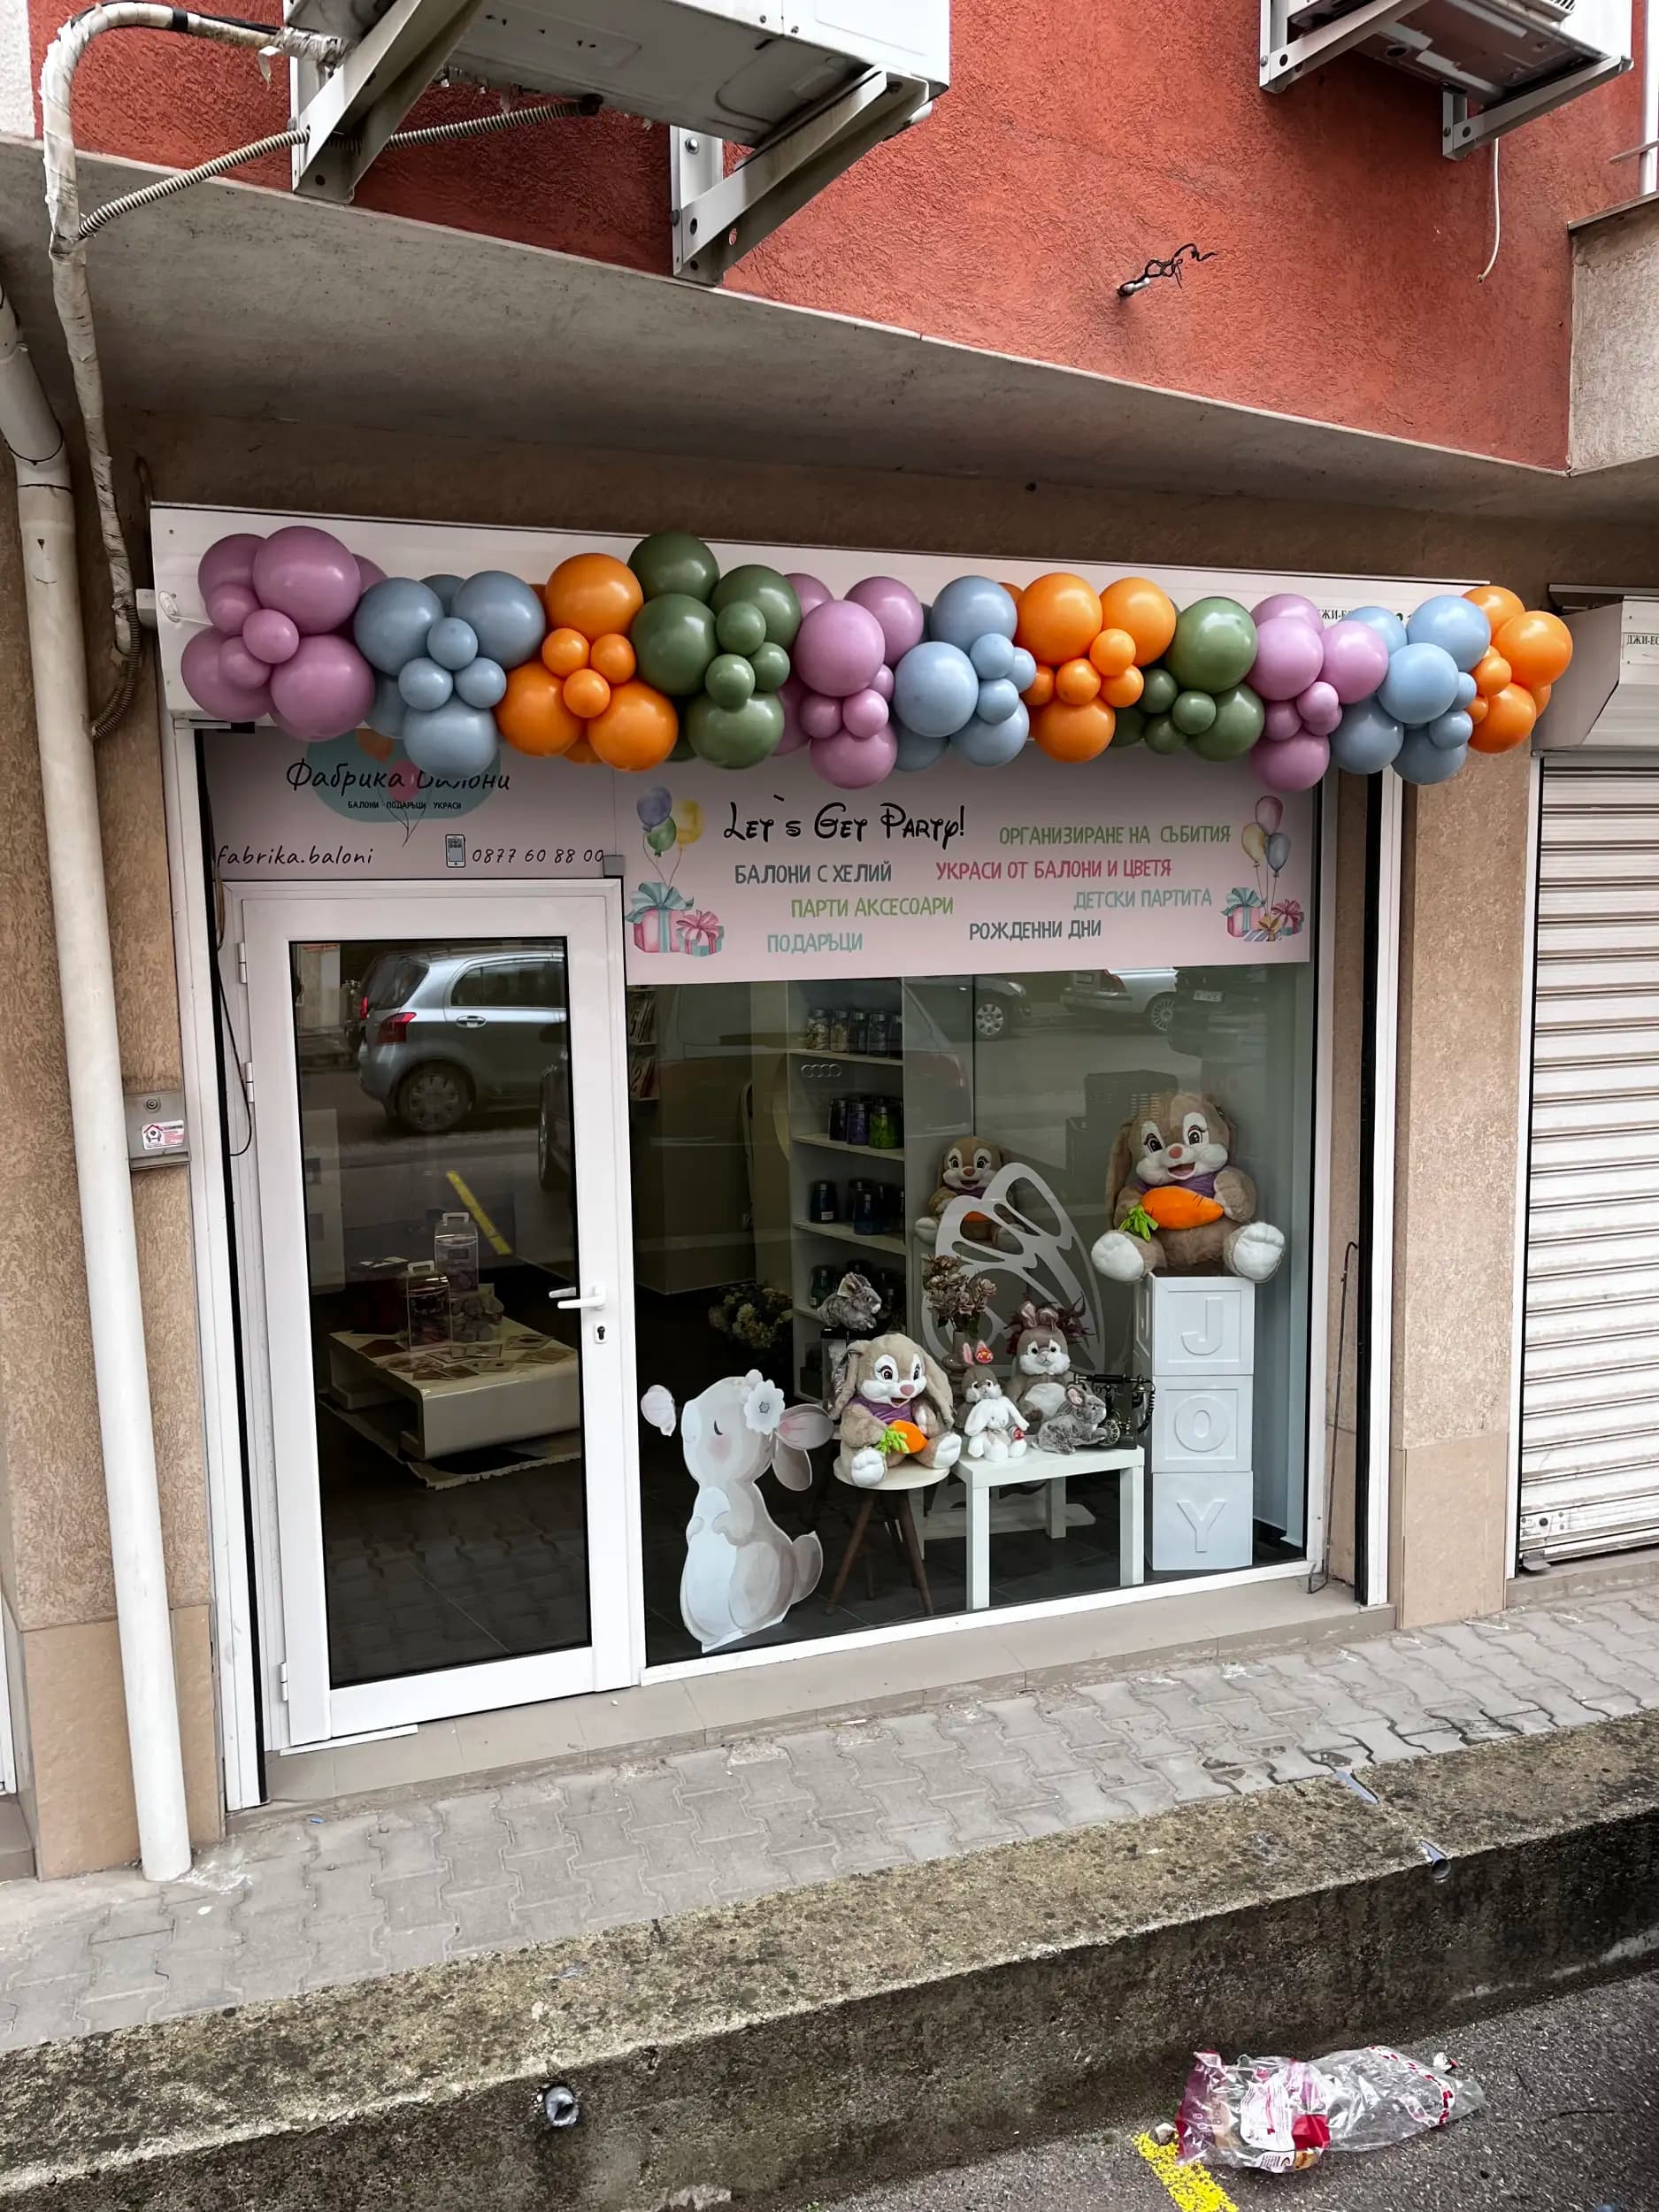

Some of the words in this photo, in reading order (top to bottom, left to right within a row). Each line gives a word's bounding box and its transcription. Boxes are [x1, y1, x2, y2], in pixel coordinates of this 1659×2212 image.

[286, 758, 405, 796] Фабрика
[348, 801, 380, 810] БАЛОНИ
[433, 801, 462, 810] УКРАСИ
[999, 826, 1124, 845] ОРГАНИЗИРАНЕ
[1128, 826, 1150, 844] НА
[1160, 825, 1232, 844] СЪБИТИЯ
[215, 844, 373, 866] fabrika.baloni
[472, 848, 517, 864] 0877
[524, 848, 547, 863] 60
[554, 847, 576, 863] 88
[583, 847, 604, 863] 00
[734, 864, 811, 884] БАЛОНИ
[817, 864, 828, 883] С
[833, 859, 893, 883] ХЕЛИЙ
[936, 861, 1002, 880] УКРАСИ
[1007, 861, 1029, 879] ОТ
[1033, 859, 1102, 879] БАЛОНИ
[1107, 858, 1118, 878] И
[1123, 858, 1172, 879] ЦВЕТЯ
[791, 898, 849, 918] ПАРТИ
[854, 896, 954, 917] АКСЕСОАРИ
[1073, 890, 1135, 910] ДЕТСКИ
[1141, 888, 1212, 909] ПАРТИТА
[970, 921, 1063, 941] РОЖДЕННИ
[1068, 919, 1102, 940] ДНИ
[767, 933, 863, 955] ПОДАРЪЦИ
